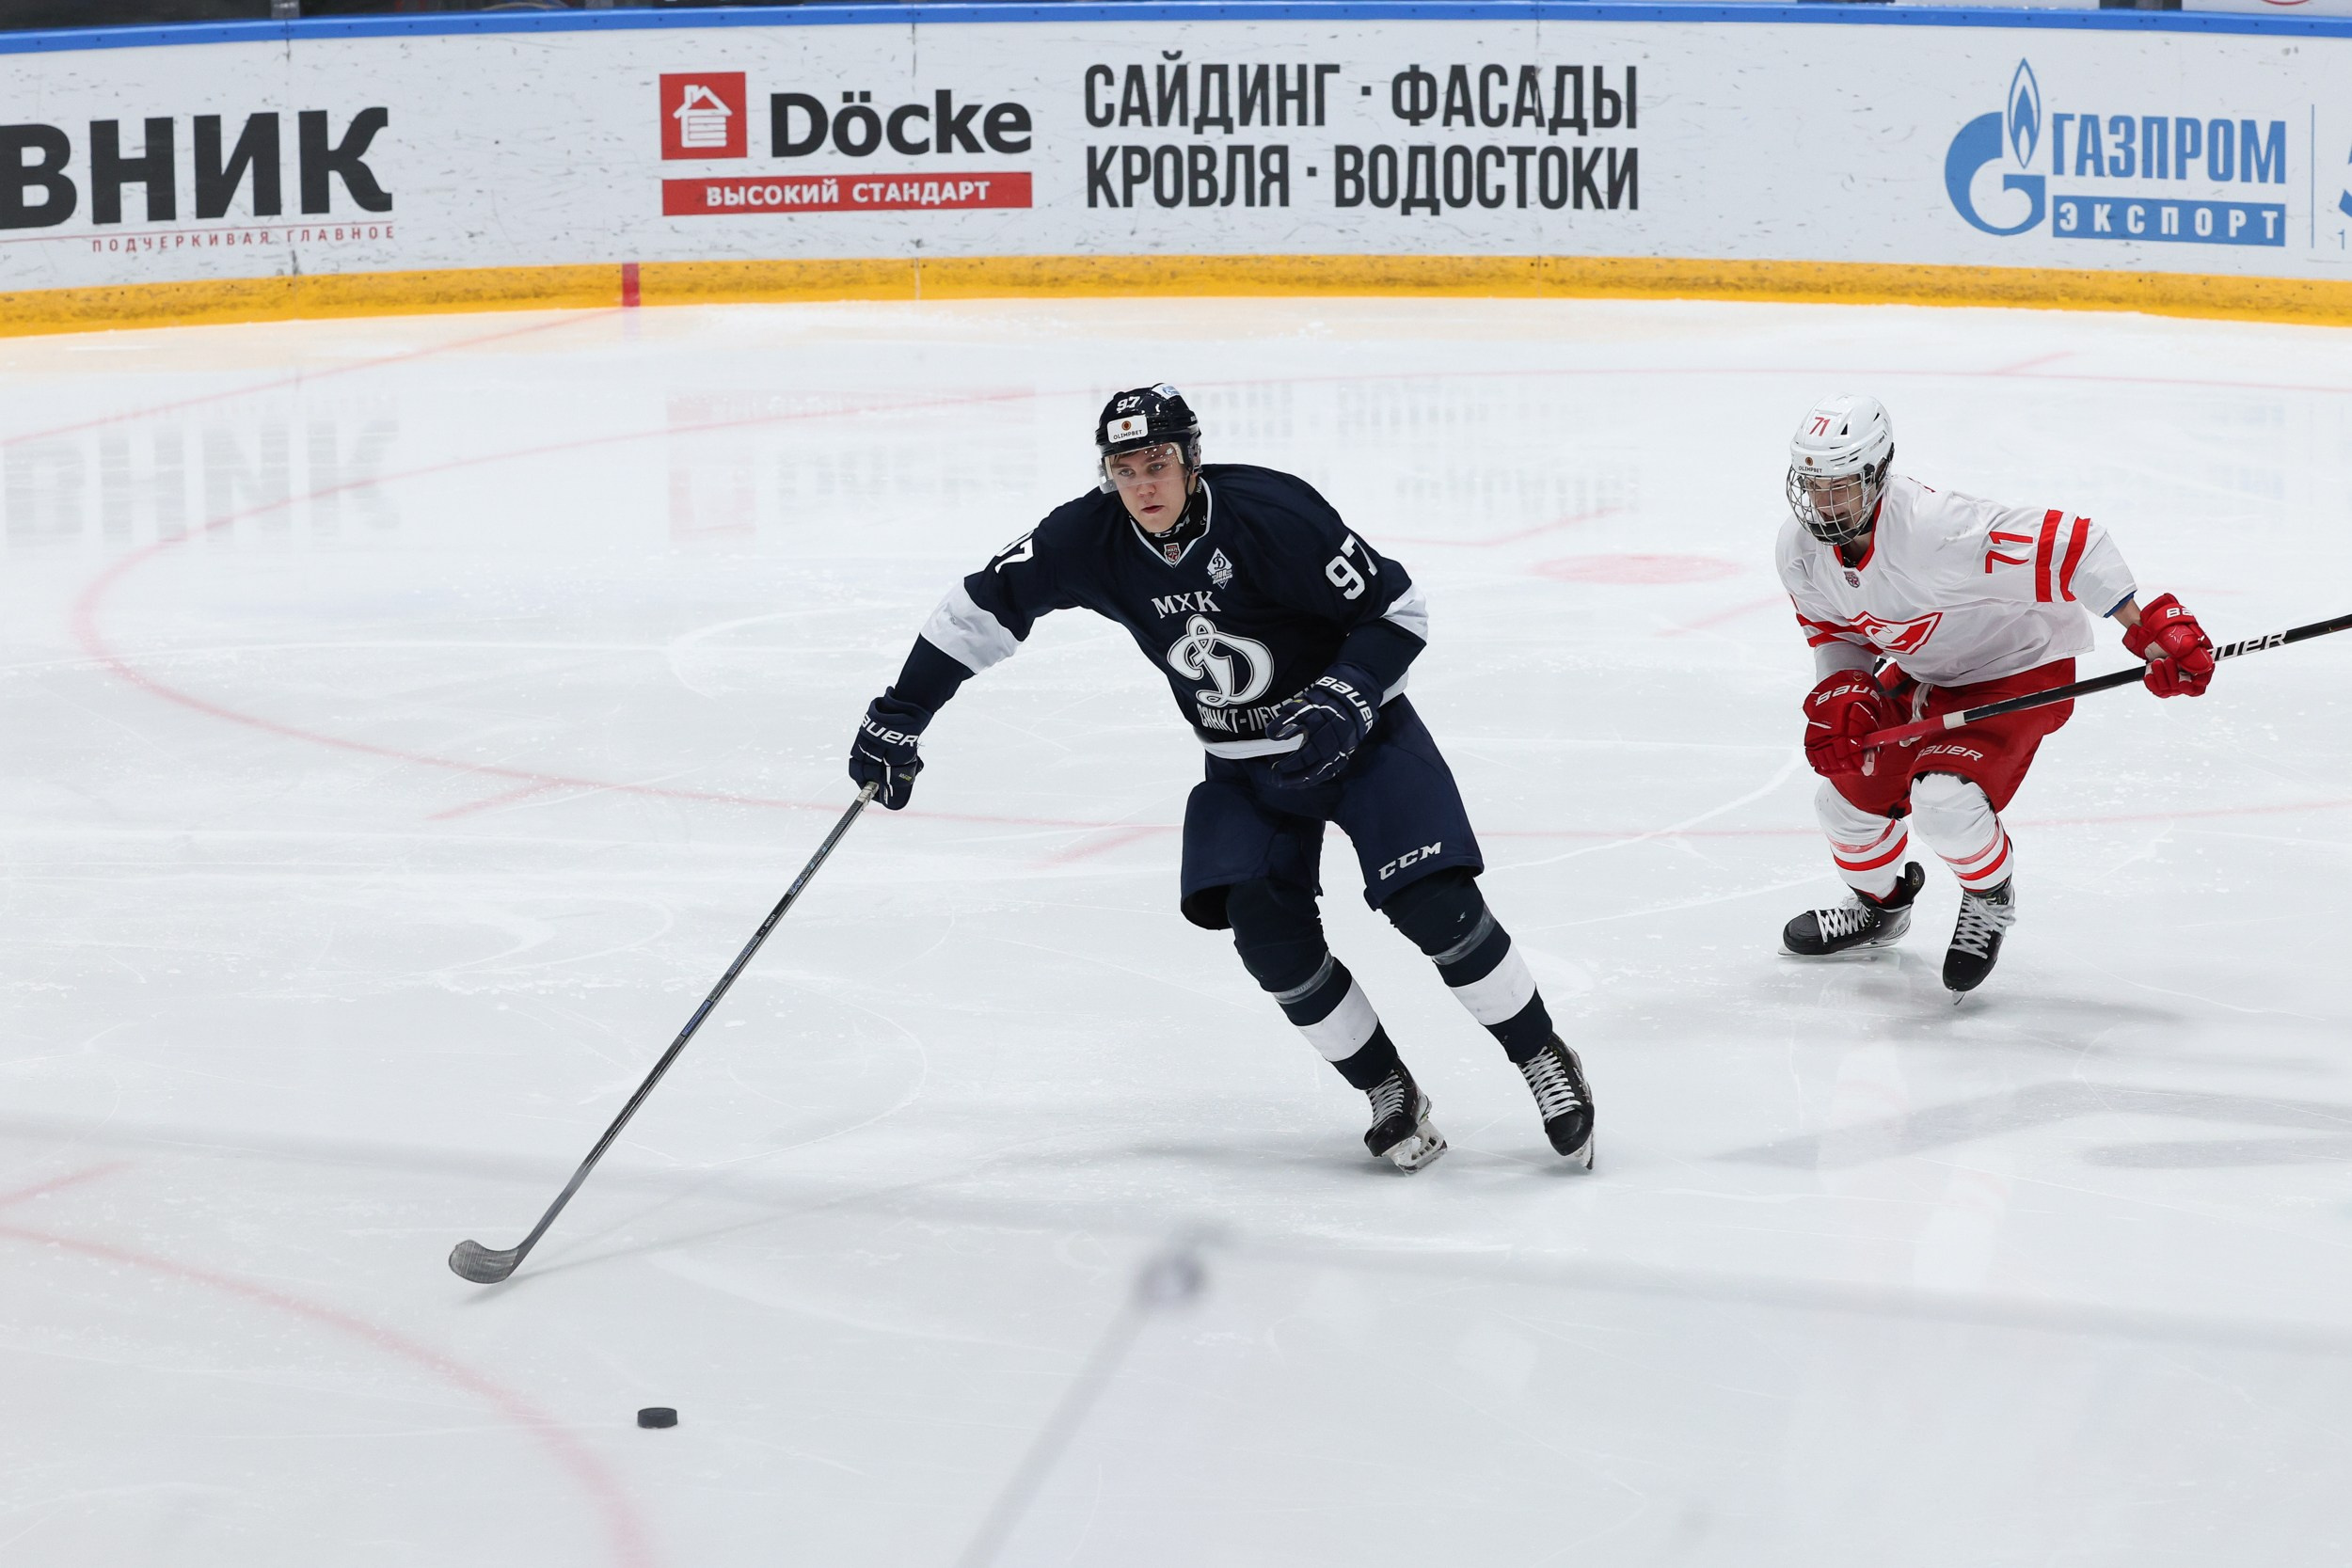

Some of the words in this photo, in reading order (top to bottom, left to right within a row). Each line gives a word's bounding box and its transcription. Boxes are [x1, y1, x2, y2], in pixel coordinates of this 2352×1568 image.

[1085, 50, 1341, 135] САЙДИНГ
[1391, 64, 1637, 136] ФАСАДЫ
[771, 89, 1032, 157] Döcke
[2053, 113, 2286, 184] ГАЗПРОМ
[707, 179, 839, 207] ВЫСОКИЙ
[852, 181, 991, 205] СТАНДАРТ
[1087, 144, 1290, 209] КРОВЛЯ
[1334, 144, 1638, 216] ВОДОСТОКИ
[92, 231, 270, 253] ПОДЧЕРКИВАЯ
[286, 226, 394, 243] ГЛАВНОЕ
[2058, 201, 2279, 240] ЭКСПОРТ
[1116, 396, 1141, 414] 97
[1113, 429, 1142, 440] OLIMPBET
[1809, 417, 1831, 436] 71
[994, 531, 1034, 574] 7
[1326, 533, 1377, 599] 97
[1984, 530, 2034, 575] 71
[861, 714, 919, 748] AUER
[1378, 841, 1442, 880] CCM
